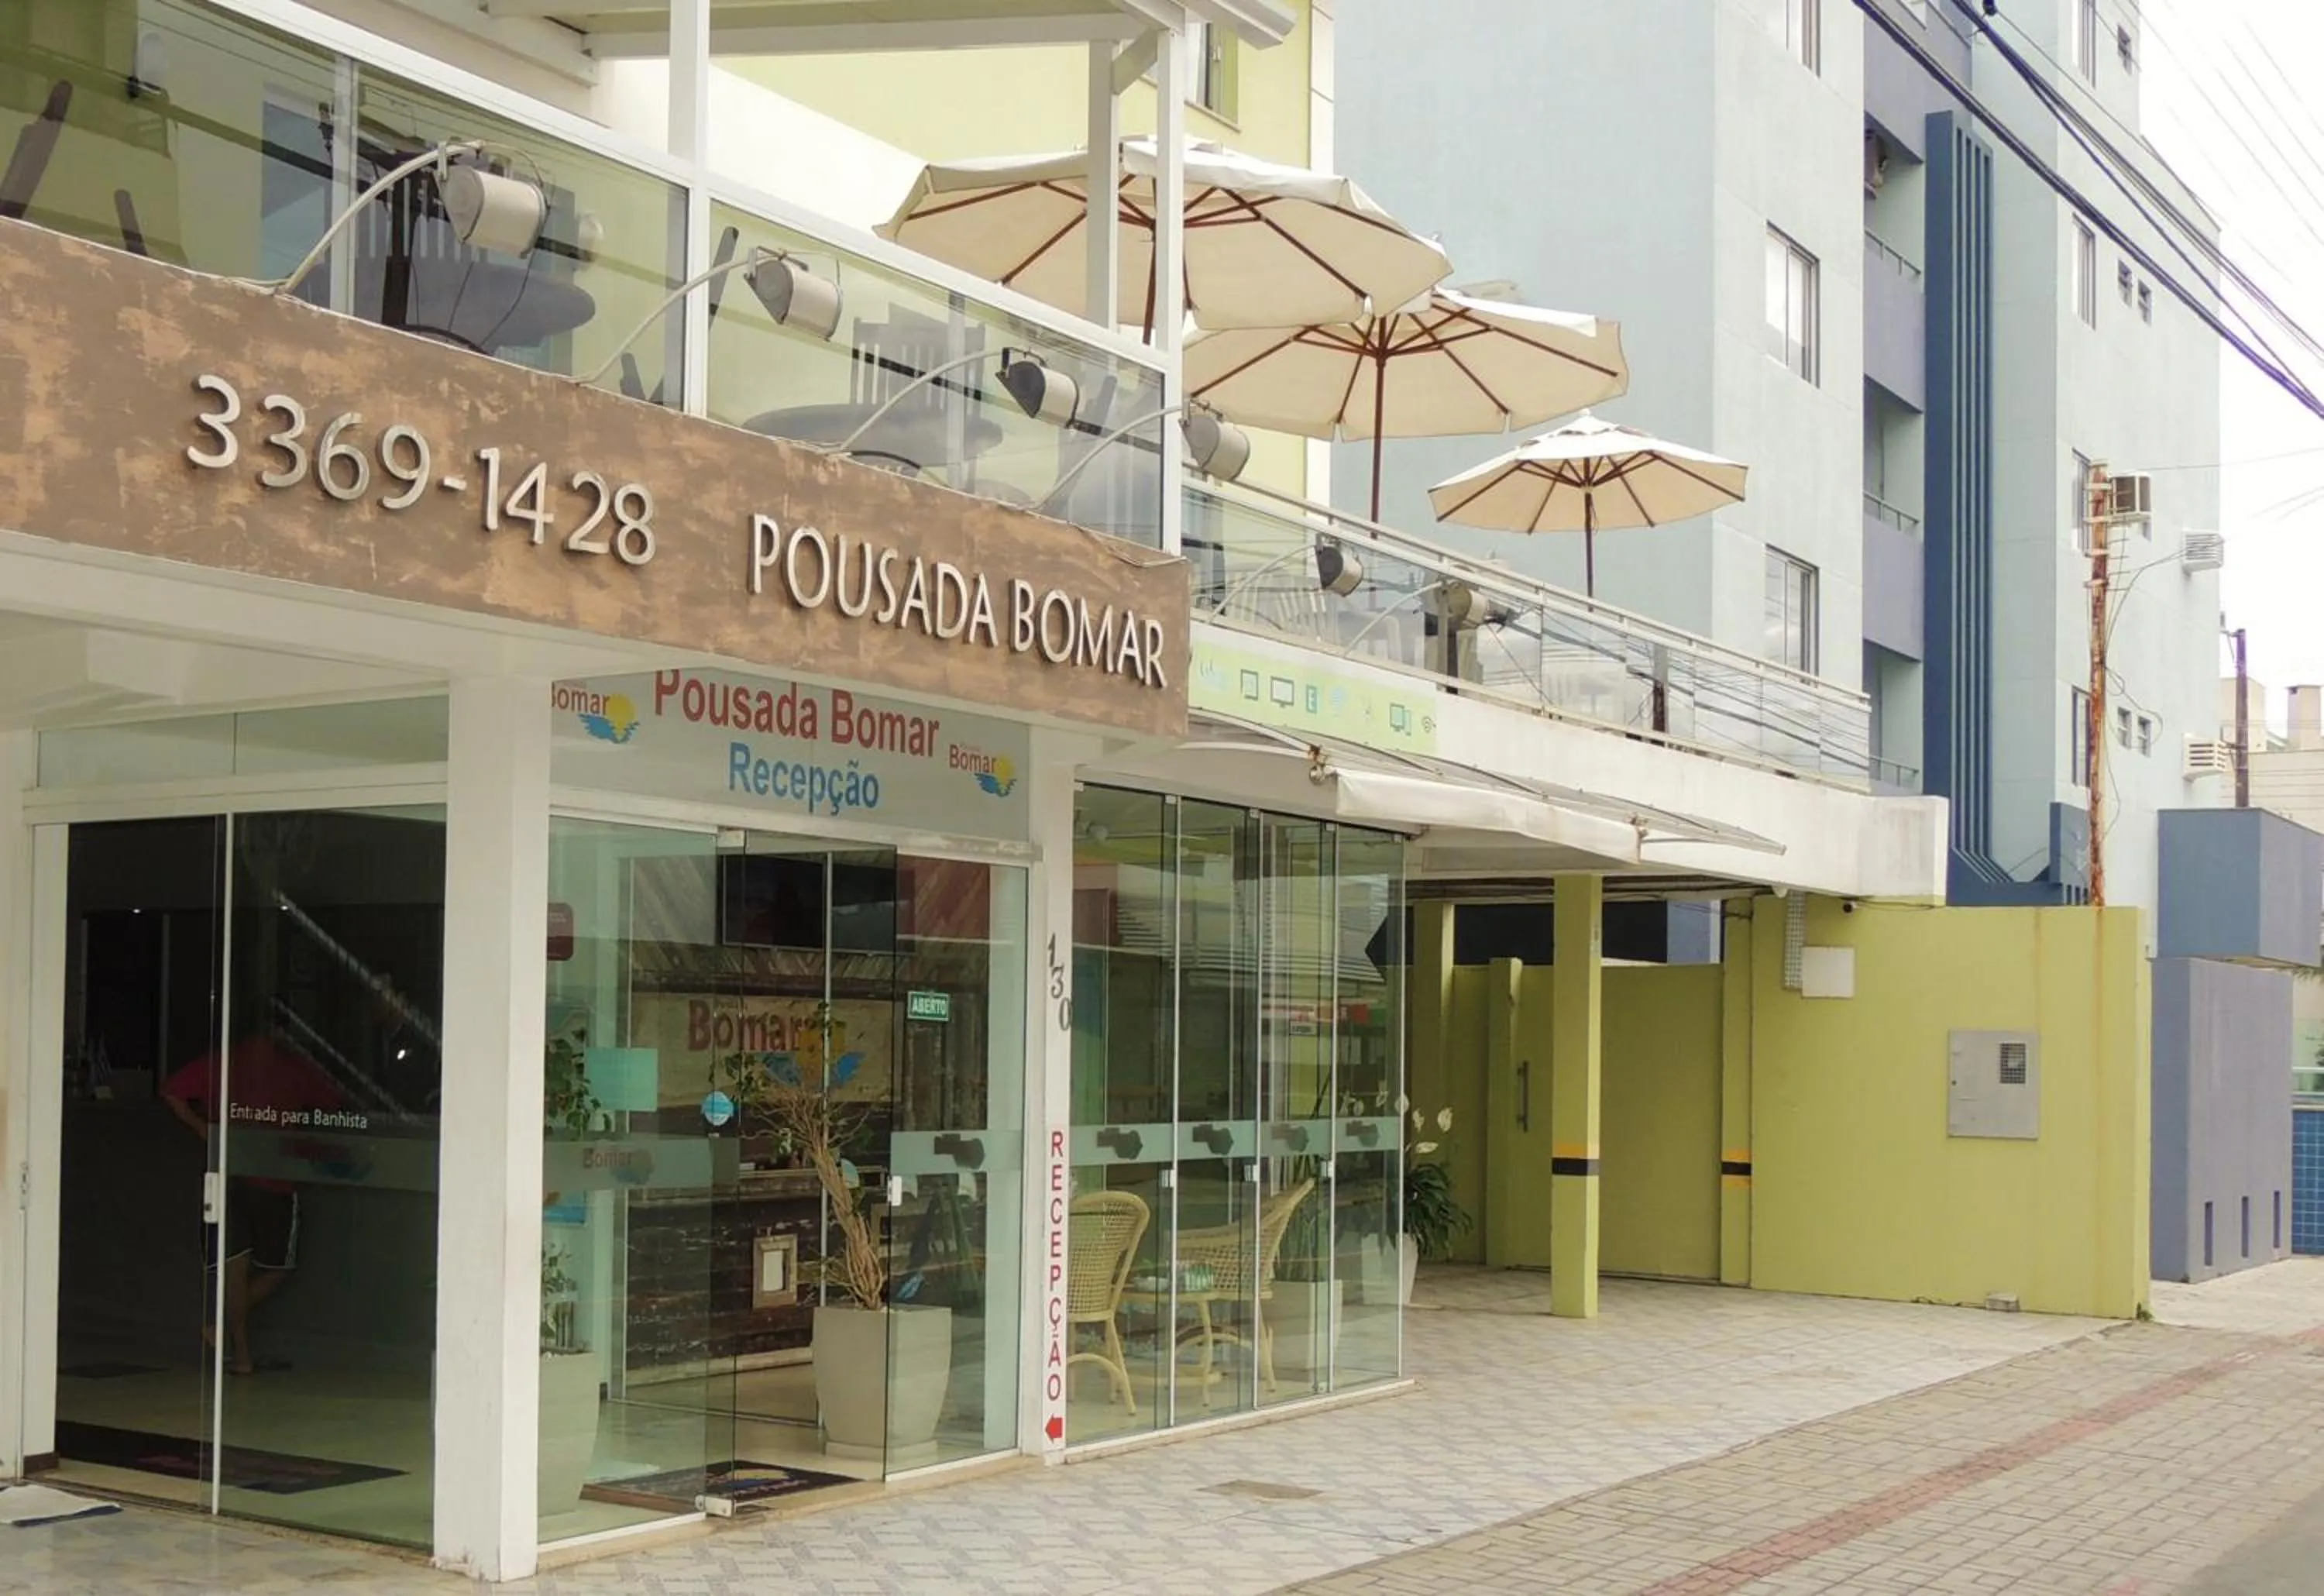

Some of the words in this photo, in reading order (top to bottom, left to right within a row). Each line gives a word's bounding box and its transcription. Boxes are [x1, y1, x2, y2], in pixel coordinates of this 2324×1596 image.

[186, 374, 656, 566] 3369-1428
[748, 513, 999, 648] POUSADA
[1009, 577, 1167, 689] BOMAR
[551, 680, 610, 715] omar
[655, 669, 818, 740] Pousada
[830, 688, 940, 758] Bomar
[728, 741, 880, 815] Recepção
[949, 744, 997, 774] Bomar
[687, 999, 803, 1052] Bomar
[281, 1110, 309, 1127] para
[314, 1109, 368, 1129] Banhista
[1047, 1130, 1064, 1402] RECEPÇÃO
